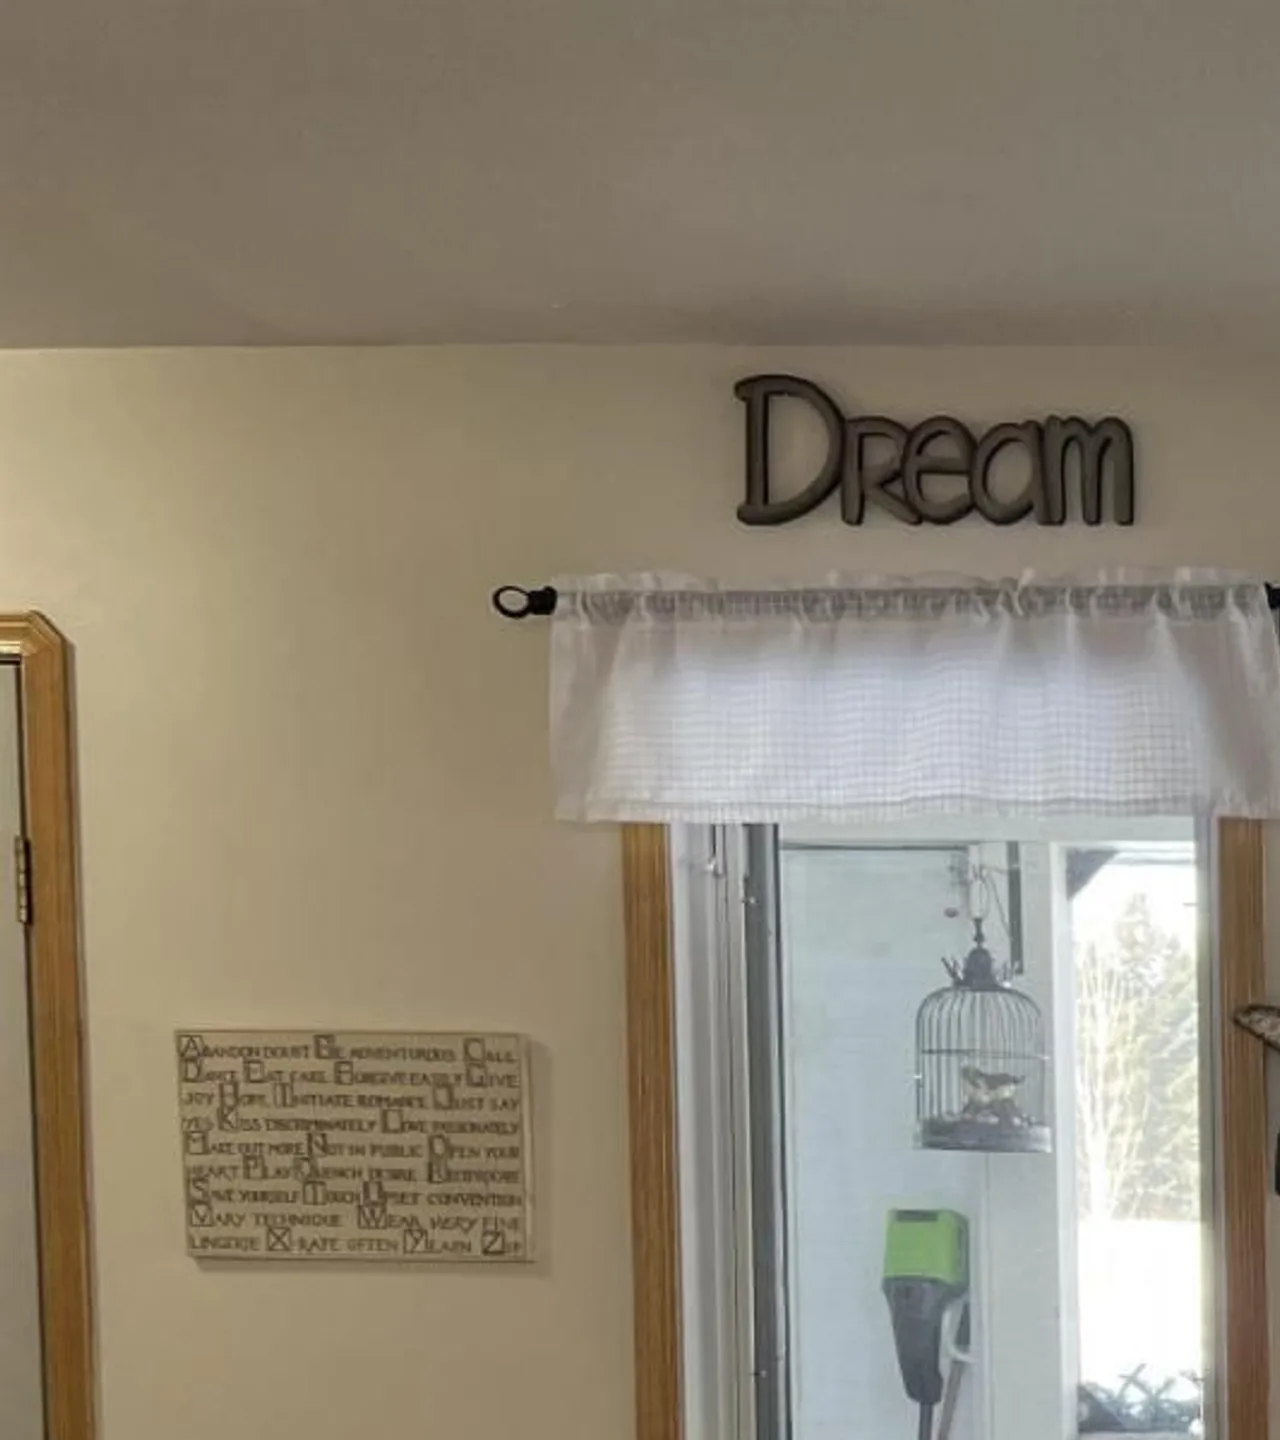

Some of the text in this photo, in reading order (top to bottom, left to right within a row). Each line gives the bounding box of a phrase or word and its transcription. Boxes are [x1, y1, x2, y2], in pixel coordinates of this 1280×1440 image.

[734, 374, 1134, 526] Dream
[490, 1098, 518, 1109] SAY
[219, 1109, 263, 1131] KISS
[308, 1133, 345, 1156] NOT
[349, 1145, 365, 1156] IN
[371, 1145, 422, 1156] PUBLIC
[190, 1204, 245, 1227] VARY
[253, 1214, 342, 1227] TECHNIQUE
[431, 1215, 478, 1229] VERY
[189, 1235, 260, 1249] LINGERIE
